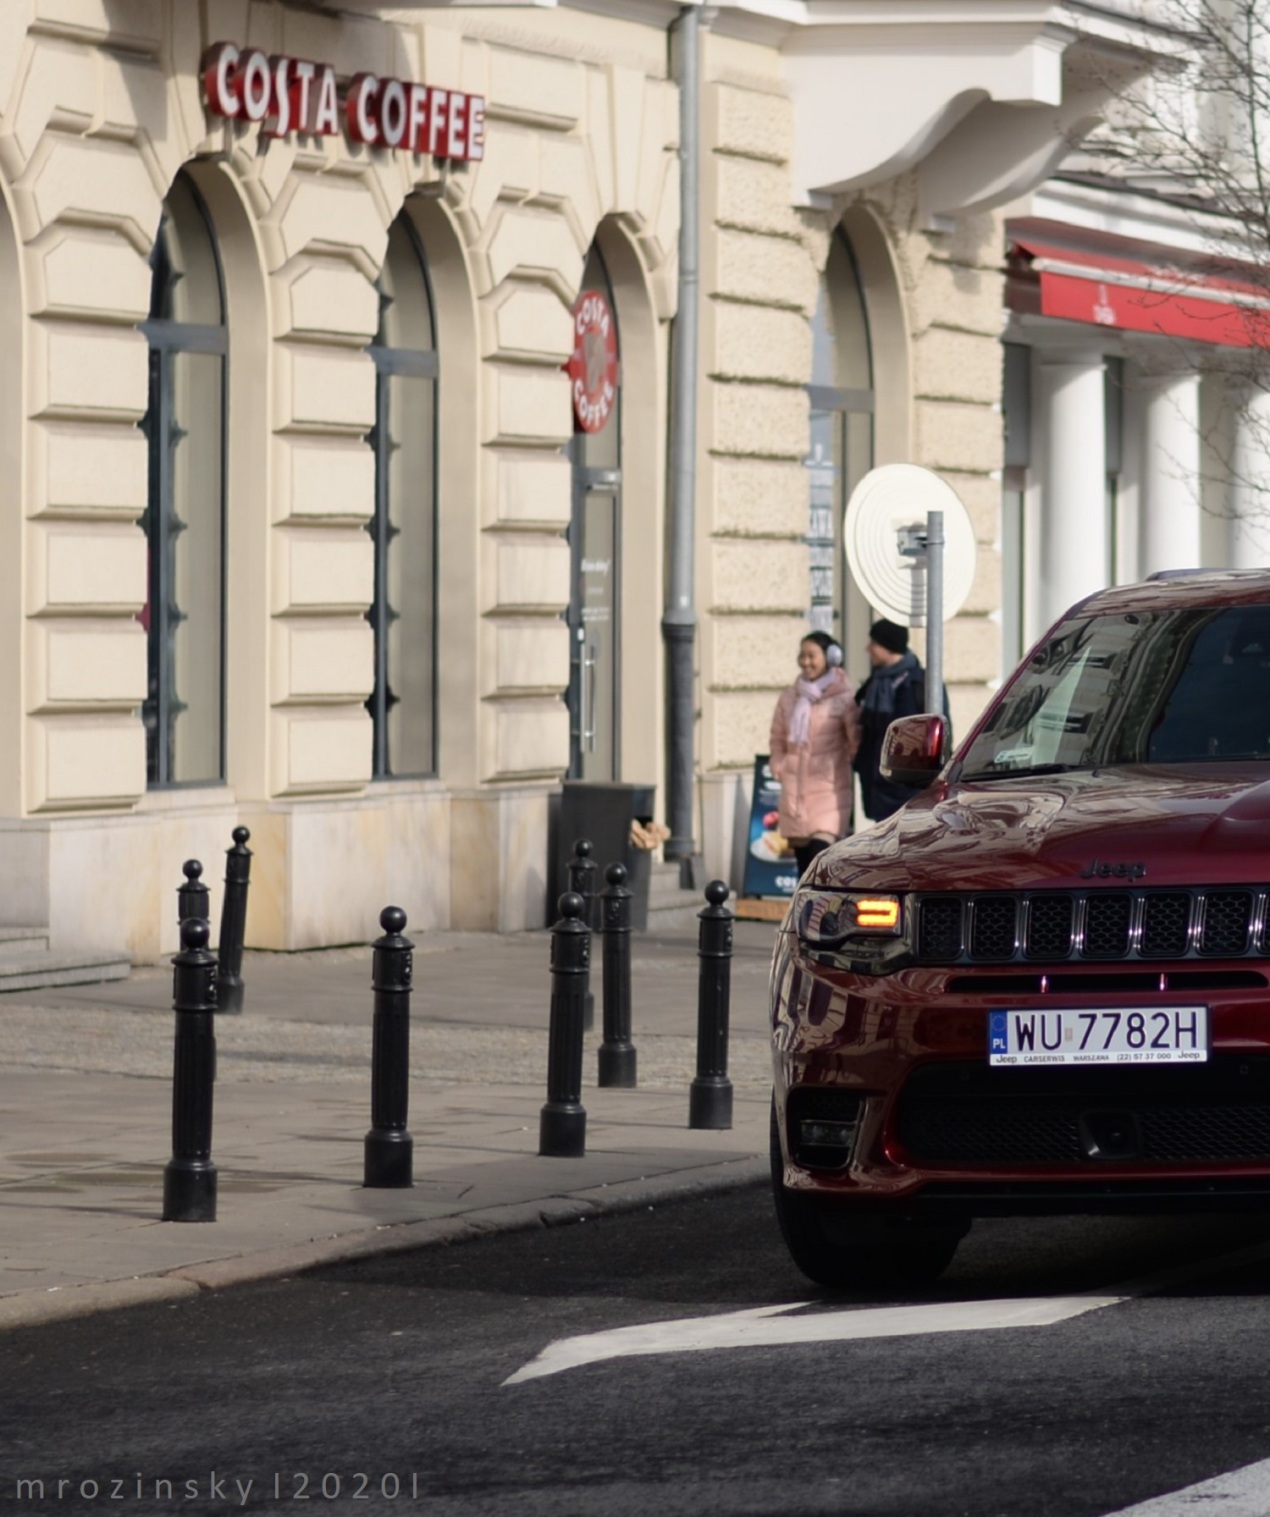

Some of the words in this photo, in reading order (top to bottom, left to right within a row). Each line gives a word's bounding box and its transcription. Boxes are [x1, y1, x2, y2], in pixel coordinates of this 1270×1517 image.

[215, 43, 338, 136] COSTA
[355, 74, 485, 159] COFFEE
[576, 297, 610, 337] COSTA
[574, 379, 614, 427] COFFEE
[1079, 858, 1147, 882] Jeep
[992, 1038, 1006, 1049] PL
[1015, 1013, 1063, 1052] WU
[1078, 1011, 1198, 1051] 7782H
[996, 1054, 1018, 1064] Jeep
[1178, 1050, 1201, 1061] Jeep
